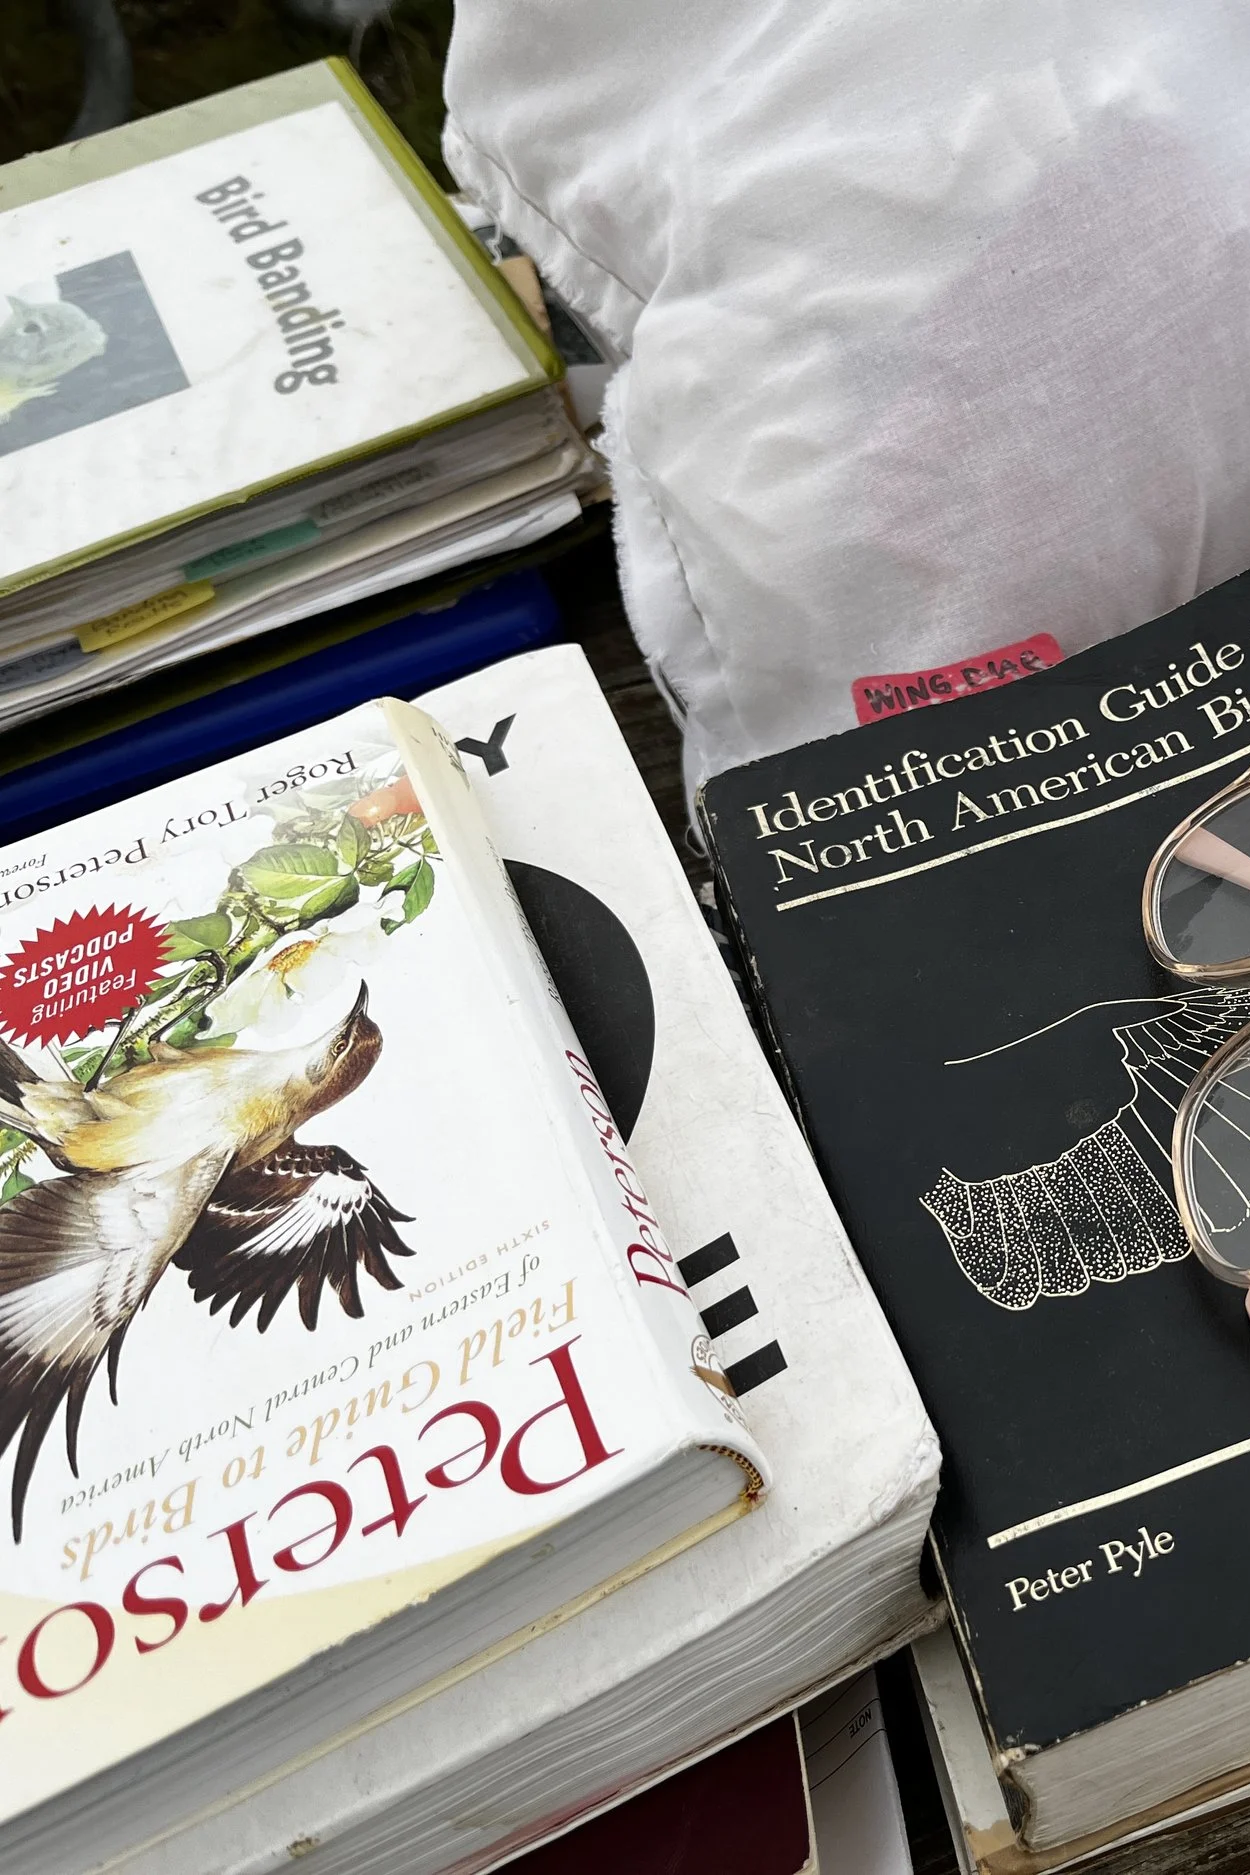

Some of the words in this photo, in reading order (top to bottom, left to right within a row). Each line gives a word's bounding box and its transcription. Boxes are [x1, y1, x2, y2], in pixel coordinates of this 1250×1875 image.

[195, 175, 288, 244] Bird
[244, 237, 348, 396] Banding
[864, 673, 952, 714] WING
[747, 716, 1090, 840] Identification
[1098, 641, 1245, 724] Guide
[256, 750, 360, 804] Roger
[767, 810, 934, 885] North
[951, 727, 1195, 832] American
[159, 799, 249, 845] Tory
[13, 922, 134, 989] PODCASTS
[43, 955, 115, 999] VIDEO
[31, 967, 137, 1027] Featuring
[565, 1049, 693, 1301] Peterson
[495, 1217, 552, 1258] SIXTH
[407, 1251, 491, 1304] EDITION
[421, 1270, 514, 1333] Eastern
[518, 1252, 542, 1289] of
[368, 1323, 415, 1371] and
[457, 1276, 581, 1386] Field
[265, 1353, 362, 1424] Central
[285, 1359, 442, 1468] Guide
[177, 1403, 257, 1461] North
[60, 1446, 173, 1516] America
[221, 1443, 268, 1489] to
[0, 1334, 625, 1722] Peterso
[60, 1475, 197, 1583] Birds
[1005, 1558, 1094, 1613] Peter
[1098, 1526, 1176, 1578] Pyle
[848, 1707, 872, 1739] NOTE
